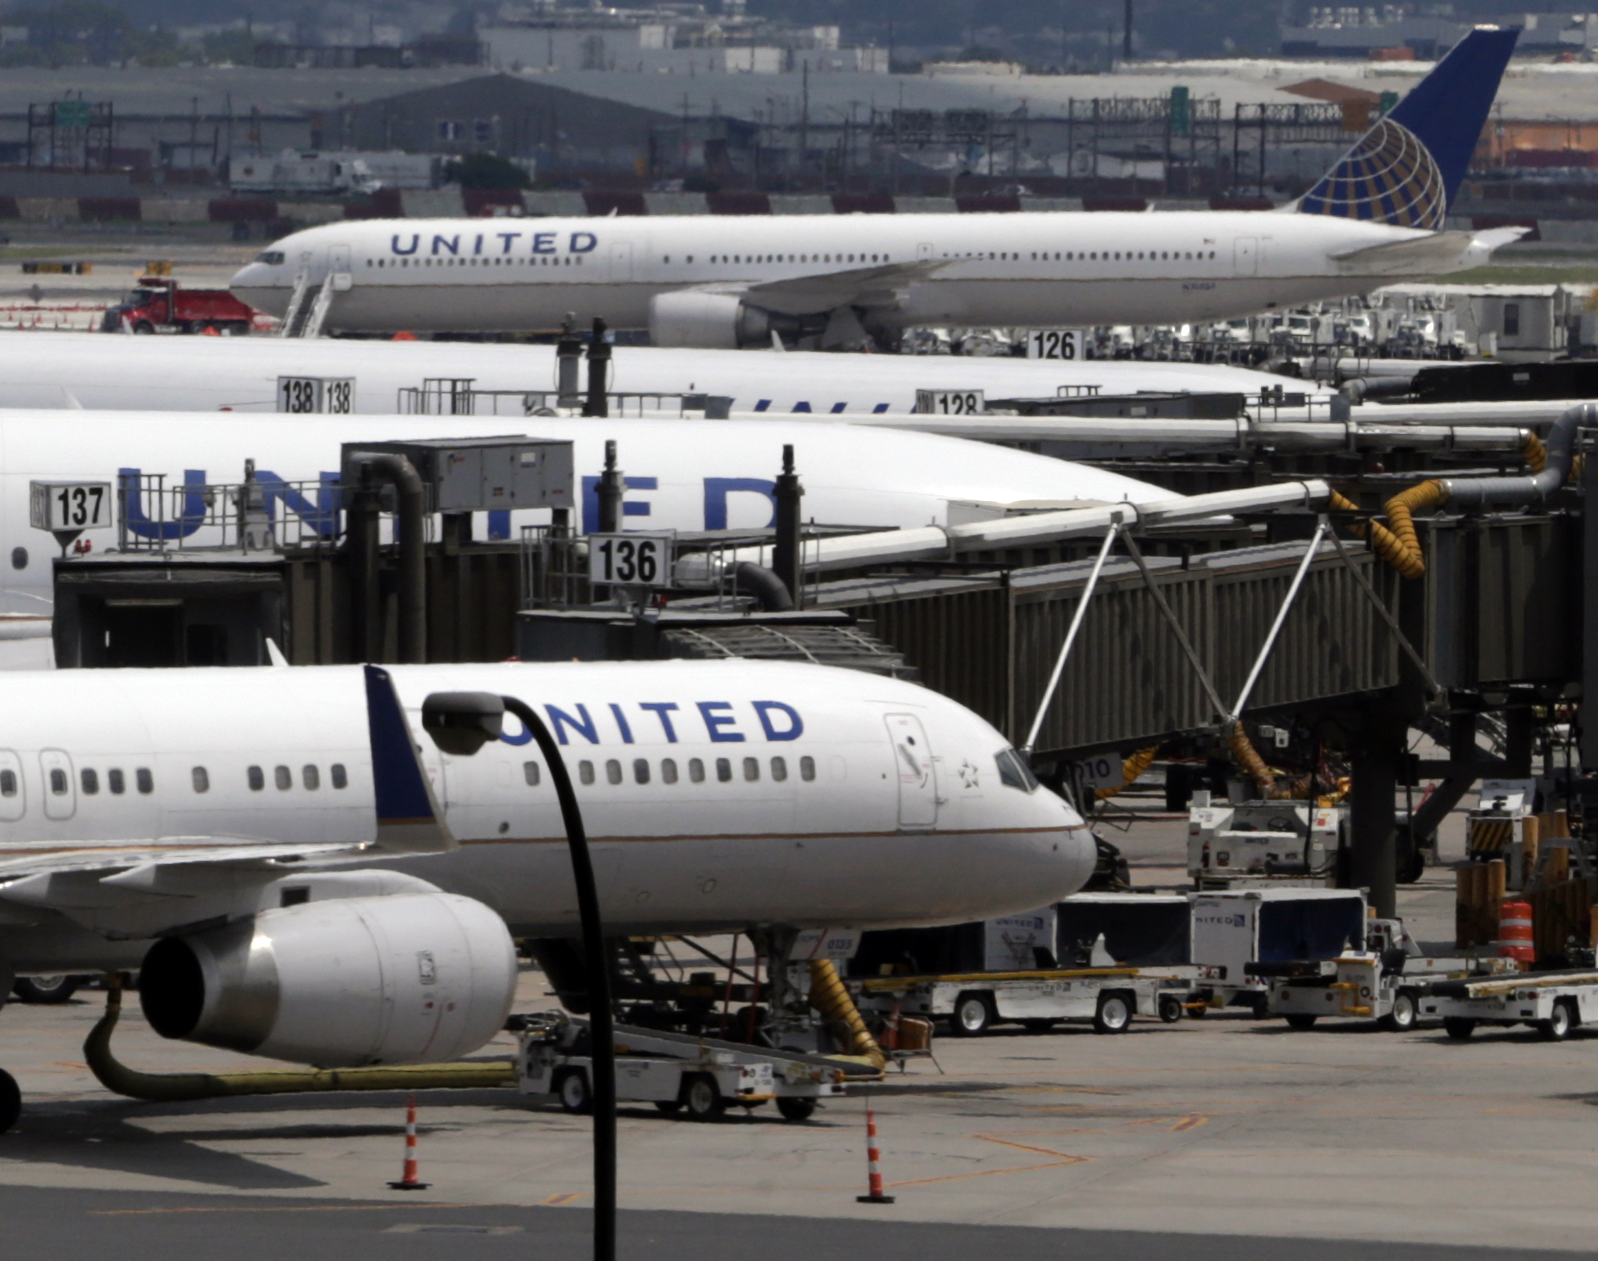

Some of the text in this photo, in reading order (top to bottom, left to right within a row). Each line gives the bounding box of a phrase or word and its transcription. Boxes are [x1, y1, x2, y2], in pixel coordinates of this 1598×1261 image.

[392, 233, 597, 254] UNITED
[1034, 331, 1075, 360] 126
[283, 380, 314, 413] 138
[327, 382, 351, 413] 138
[939, 393, 977, 414] 128
[58, 487, 104, 526] 137
[599, 540, 657, 582] 136
[996, 918, 1034, 928] UNITED
[1195, 916, 1233, 925] NITED
